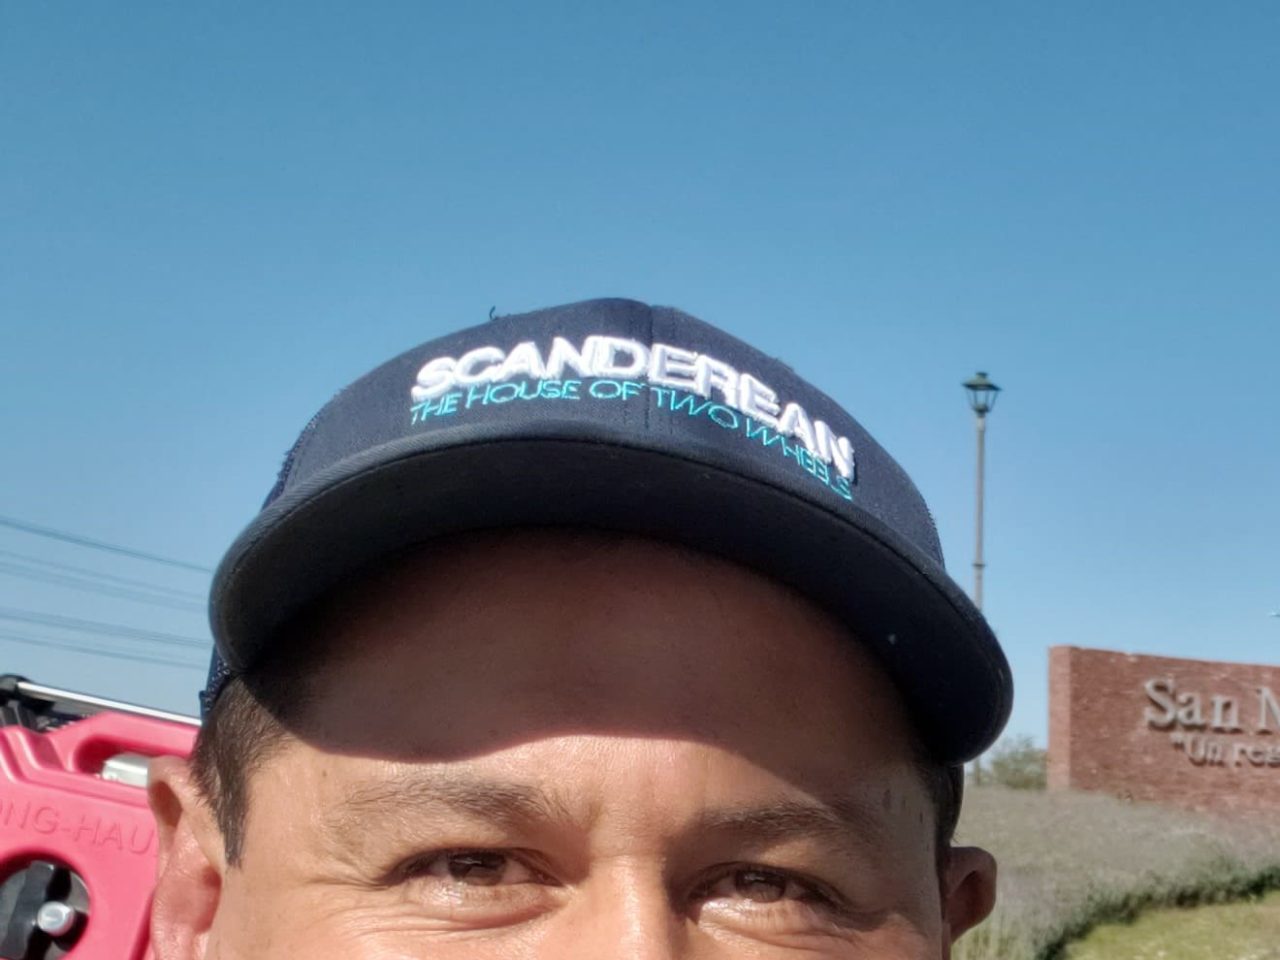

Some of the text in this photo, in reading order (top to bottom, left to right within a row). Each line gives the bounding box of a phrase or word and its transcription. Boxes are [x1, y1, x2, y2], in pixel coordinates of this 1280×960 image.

[410, 379, 854, 501] THE HOUSE OF TWO WHEELS
[411, 335, 856, 480] SCANDEREAN
[1144, 676, 1240, 731] San
